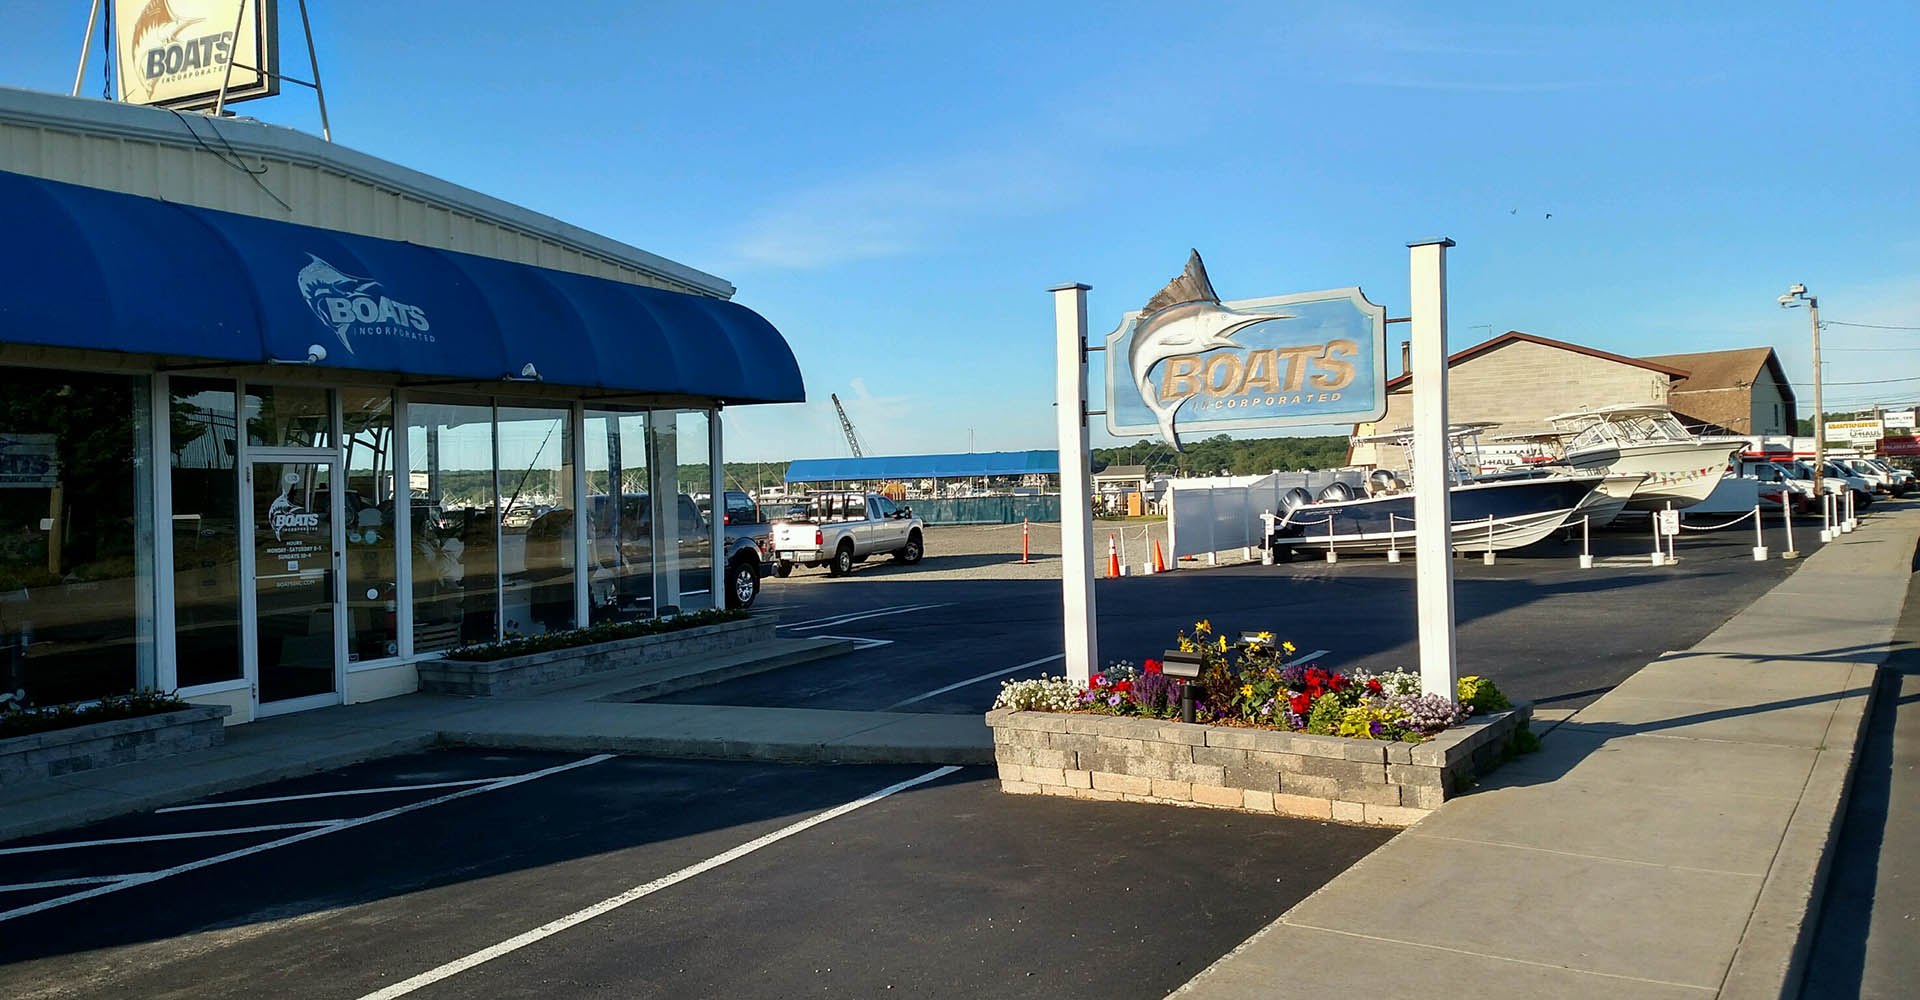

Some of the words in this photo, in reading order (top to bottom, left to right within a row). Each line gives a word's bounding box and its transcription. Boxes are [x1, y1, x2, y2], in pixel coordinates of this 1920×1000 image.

[146, 31, 233, 79] BOATS
[326, 295, 429, 331] BOATS
[353, 327, 435, 342] INCORPORATED
[1160, 340, 1359, 401] BOATS
[1192, 393, 1341, 410] INCORPORATED
[276, 514, 319, 526] BOATS
